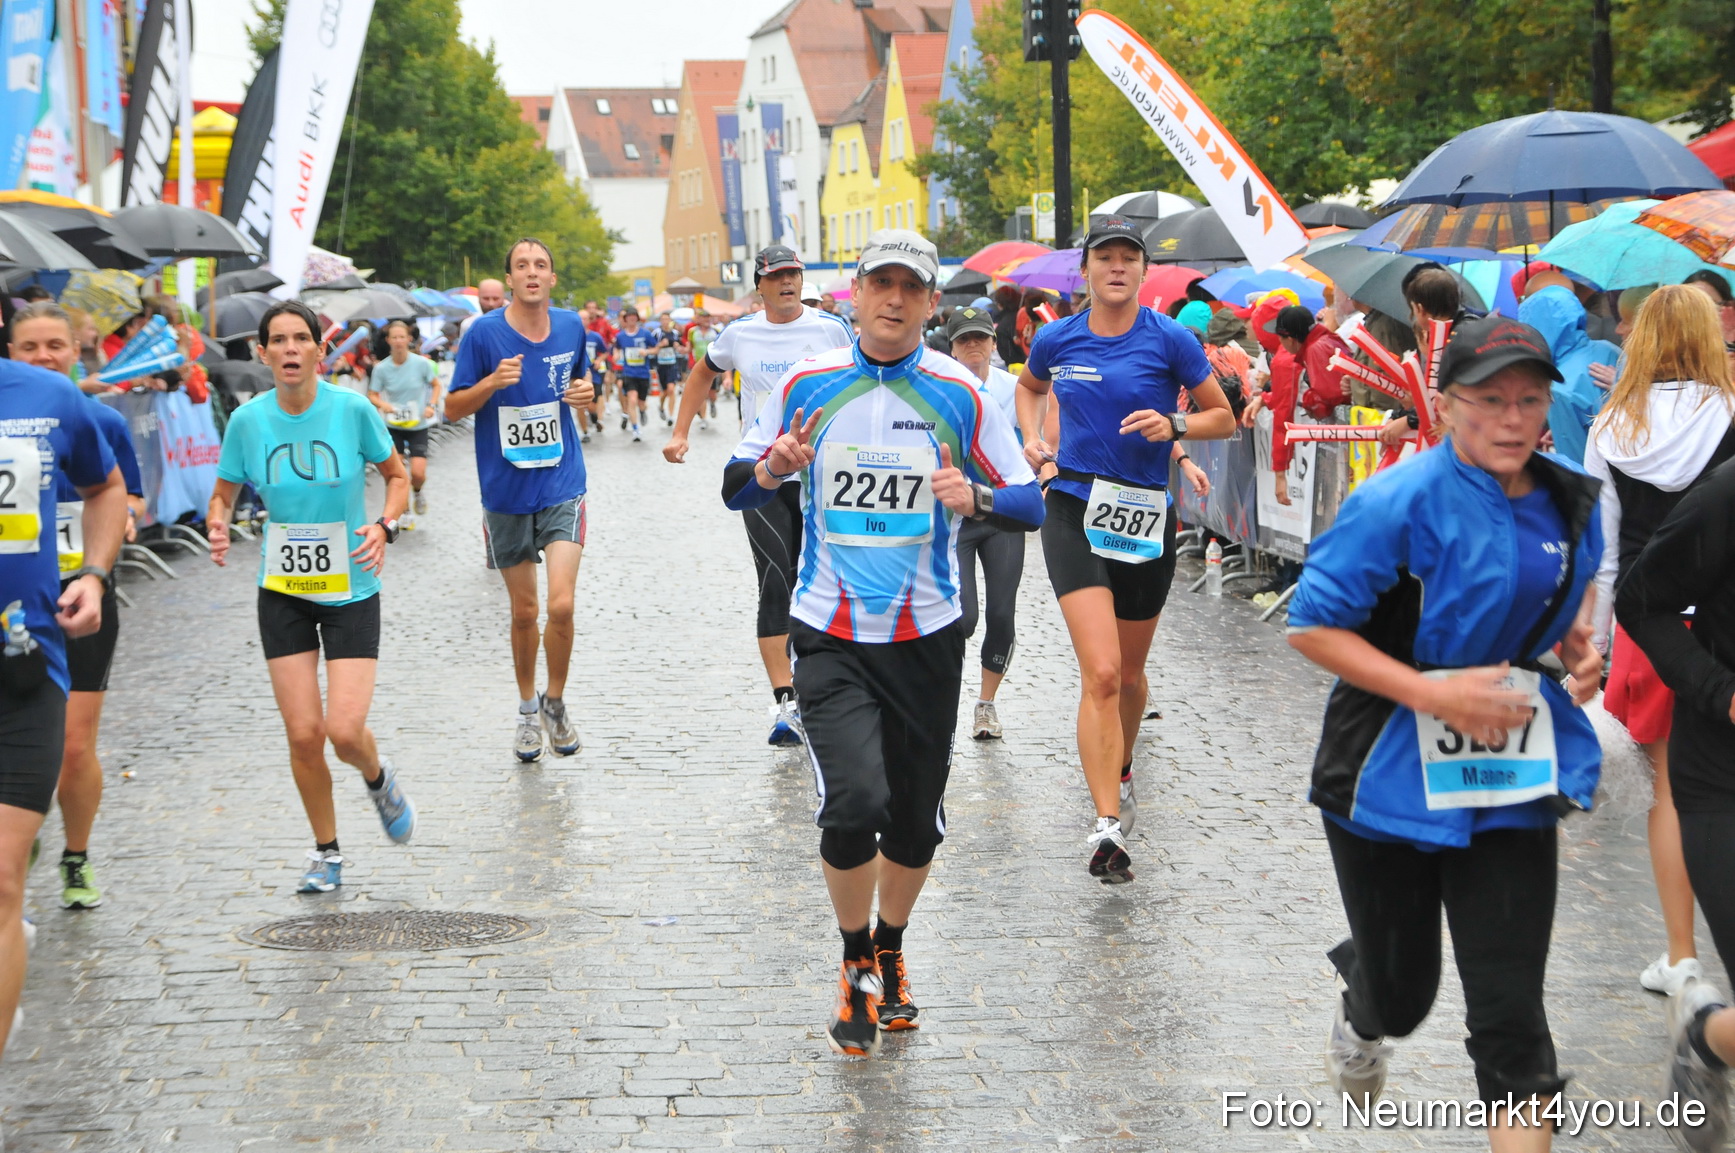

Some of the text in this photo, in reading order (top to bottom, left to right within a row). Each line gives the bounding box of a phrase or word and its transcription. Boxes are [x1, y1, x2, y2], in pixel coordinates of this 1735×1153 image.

[126, 21, 178, 207] HULE
[290, 71, 329, 230] Audi BKK
[880, 242, 924, 257] saller
[507, 419, 557, 446] 3430
[915, 421, 936, 431] RACER
[265, 440, 340, 485] run
[857, 452, 900, 463] BOCK
[833, 470, 924, 510] 2247
[1118, 491, 1149, 502] BOCK
[866, 518, 886, 532] Ivo
[1091, 502, 1161, 538] 2587
[287, 528, 319, 537] BOCK
[1103, 535, 1138, 552] Gisela
[280, 544, 331, 573] 358
[285, 579, 327, 591] Kristina
